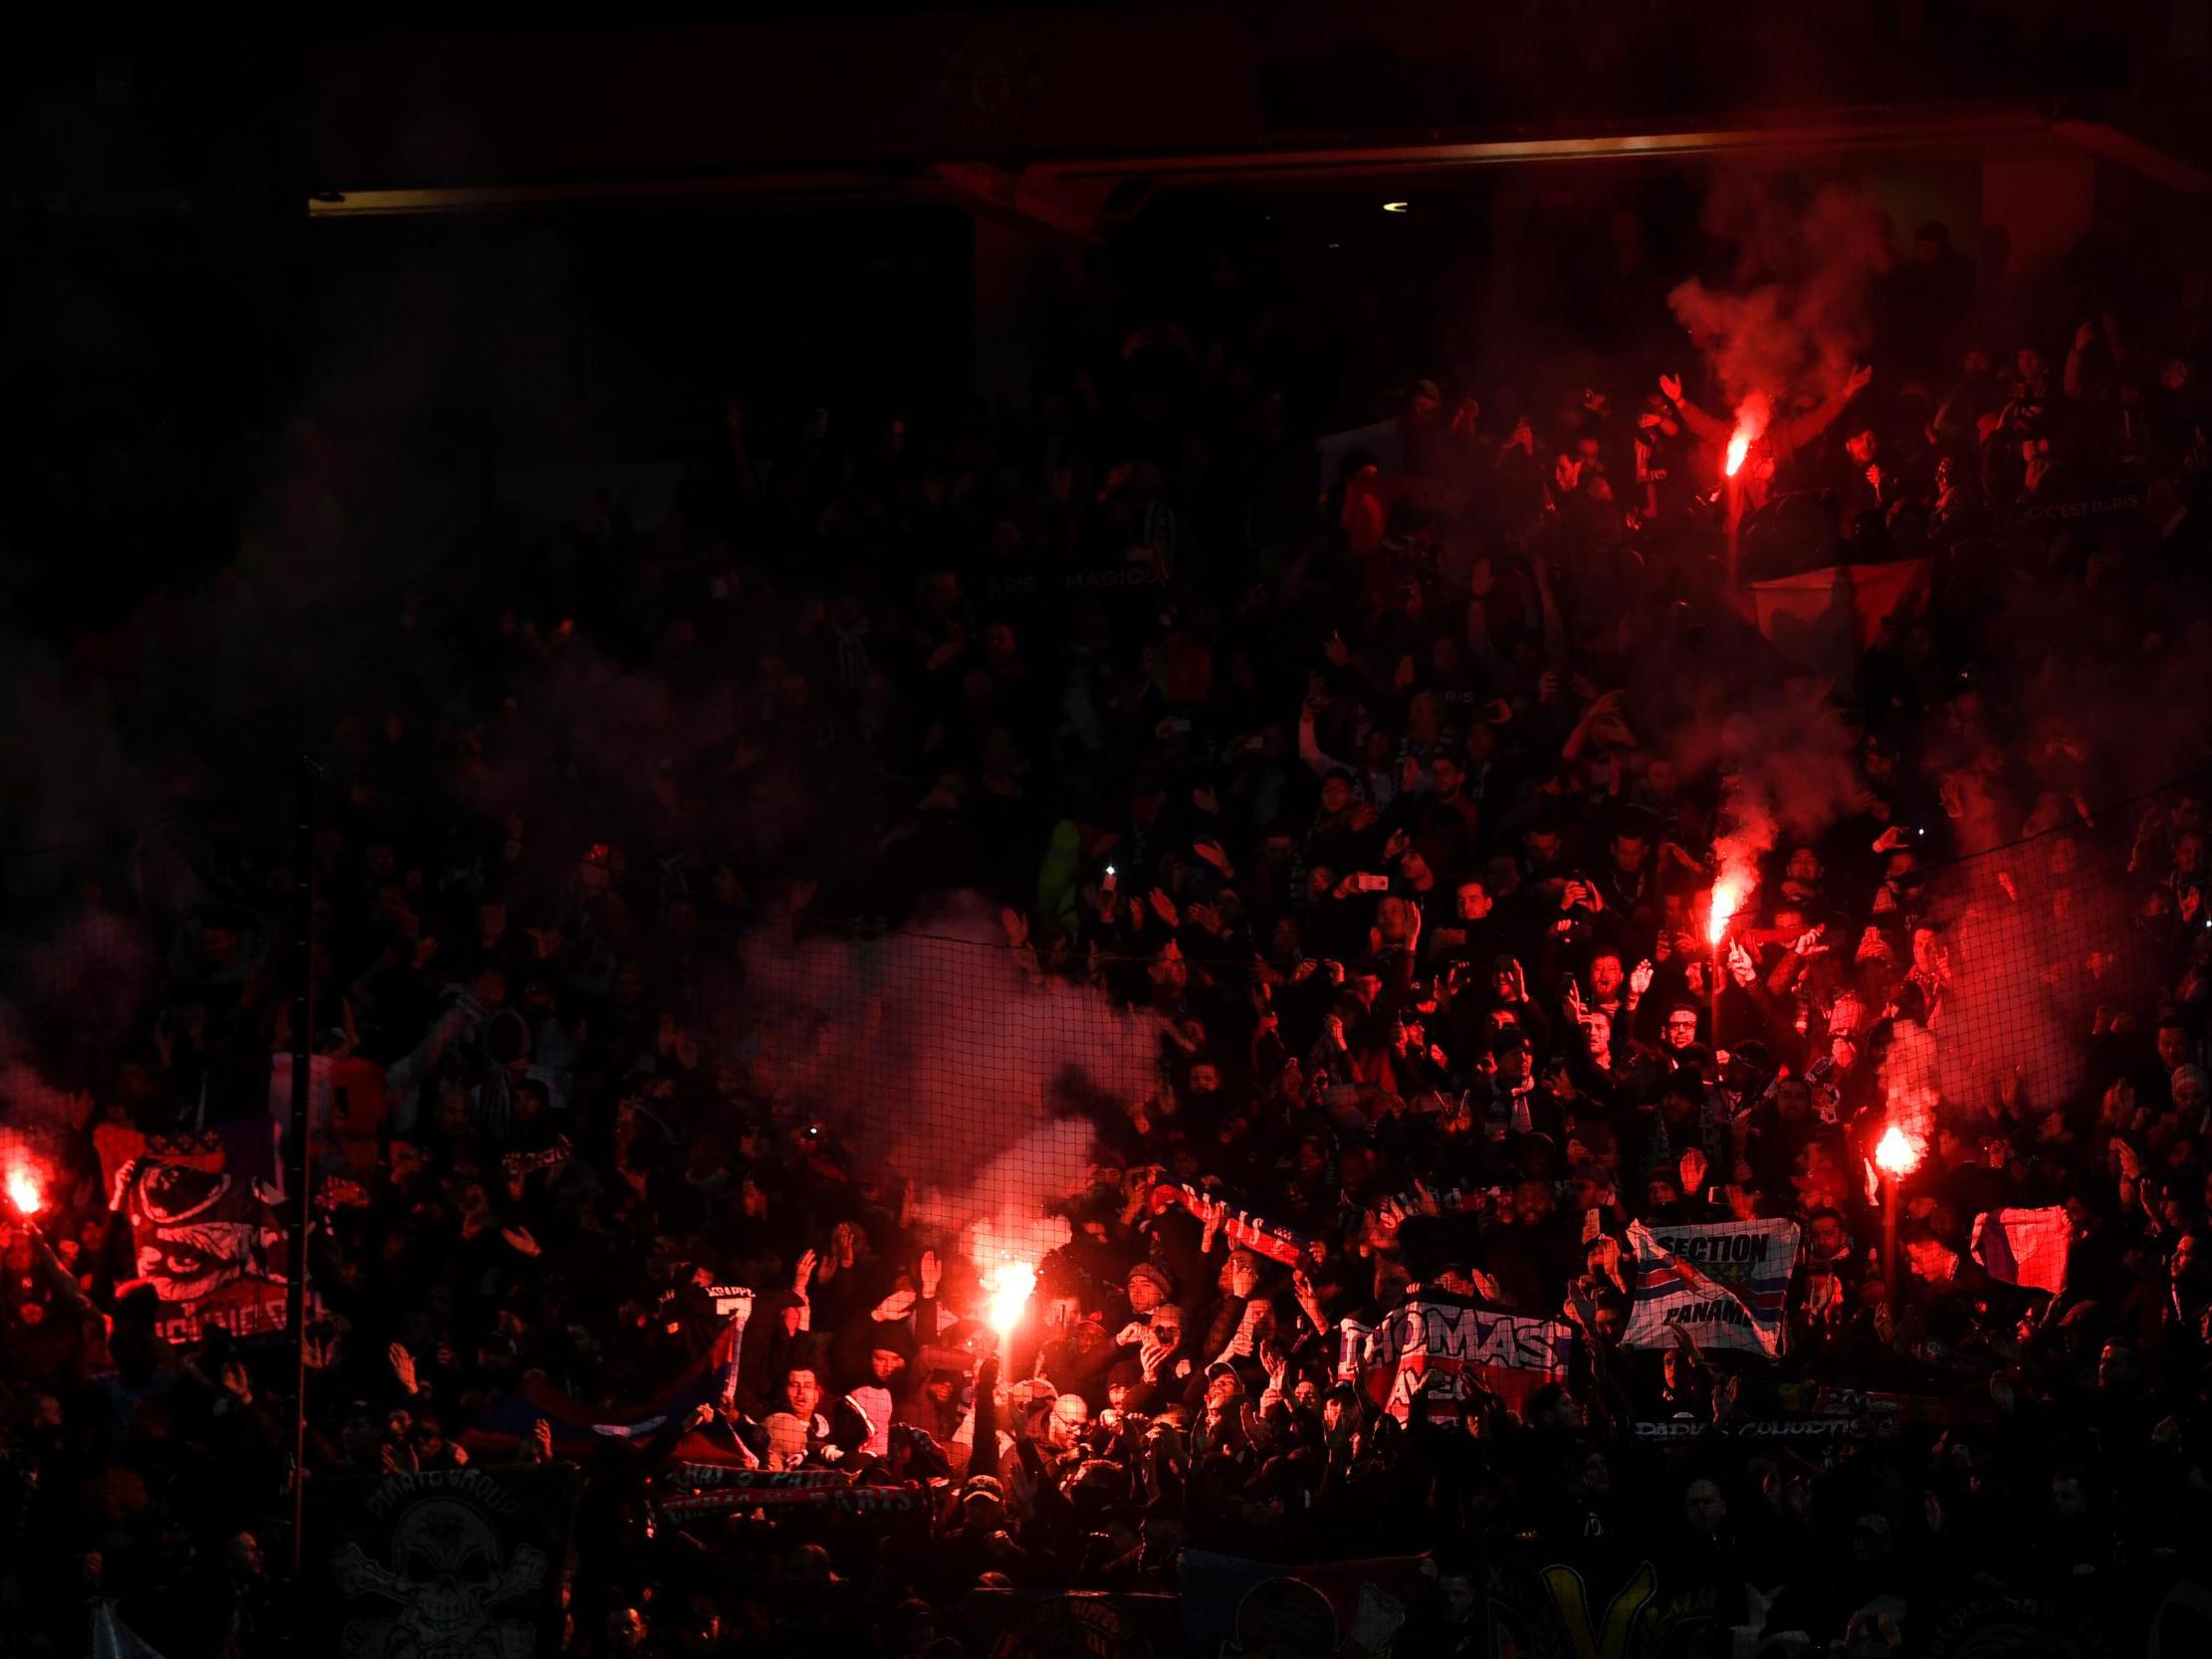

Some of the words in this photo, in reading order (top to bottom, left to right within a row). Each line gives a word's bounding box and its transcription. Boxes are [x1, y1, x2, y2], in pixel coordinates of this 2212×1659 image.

[1064, 567, 1163, 590] MAGIQU
[1657, 1233, 1770, 1263] SECTION
[1344, 1306, 1559, 1372] THOMAS
